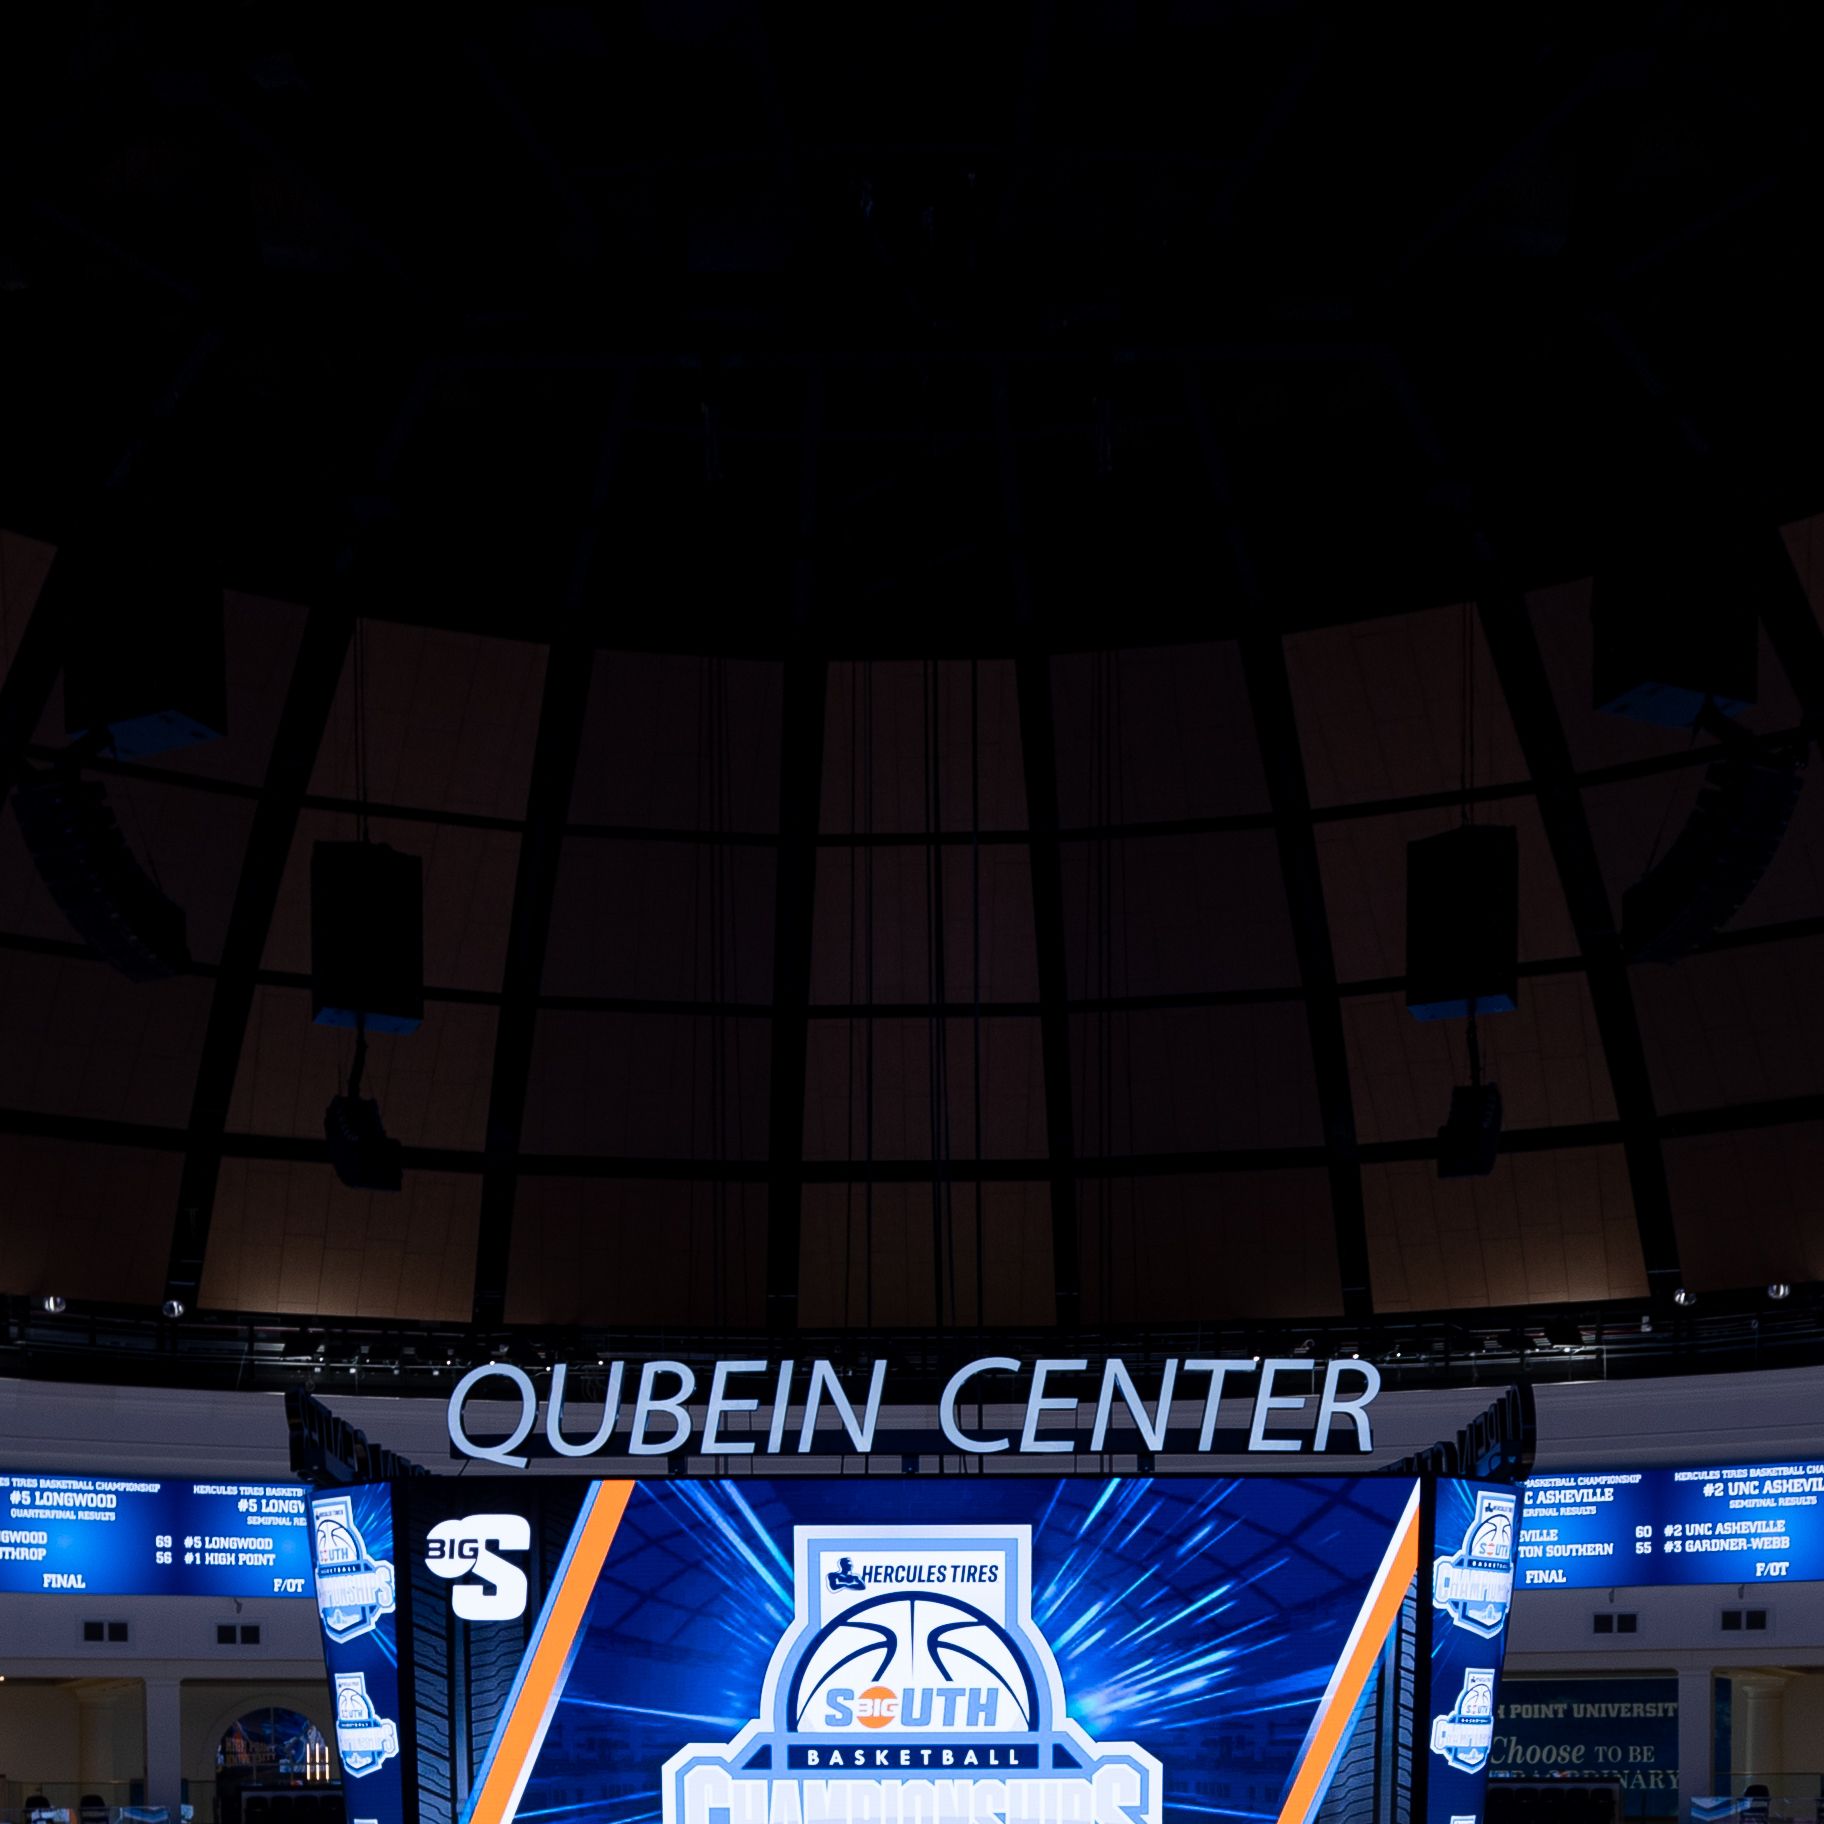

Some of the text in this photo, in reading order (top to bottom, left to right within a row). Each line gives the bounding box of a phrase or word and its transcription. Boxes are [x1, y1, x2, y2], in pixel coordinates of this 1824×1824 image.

[446, 1356, 1382, 1471] QUBEIN CENTER
[1537, 1488, 1614, 1504] ASHEVILLE
[1703, 1483, 1724, 1497] #2
[1728, 1481, 1759, 1496] UNC
[35, 1492, 117, 1509] LONGWOOD
[1685, 1520, 1786, 1536] UNC ASHEVILLE
[205, 1536, 273, 1551] LONGWOOD
[426, 1536, 479, 1563] BIG
[1546, 1543, 1613, 1557] SOUTHERN
[1685, 1536, 1790, 1552] GARDNER-WEBB
[205, 1552, 276, 1566] HIGH POINT
[860, 1562, 1000, 1587] HERCULES TIRES
[1525, 1570, 1566, 1583] FINAL
[1756, 1562, 1789, 1576] F/OT
[43, 1574, 86, 1589] FINAL
[858, 1697, 898, 1717] BIG
[1510, 1702, 1567, 1719] POINT
[1490, 1736, 1655, 1764] Choose TO BE
[807, 1748, 1023, 1769] BASKETBALL
